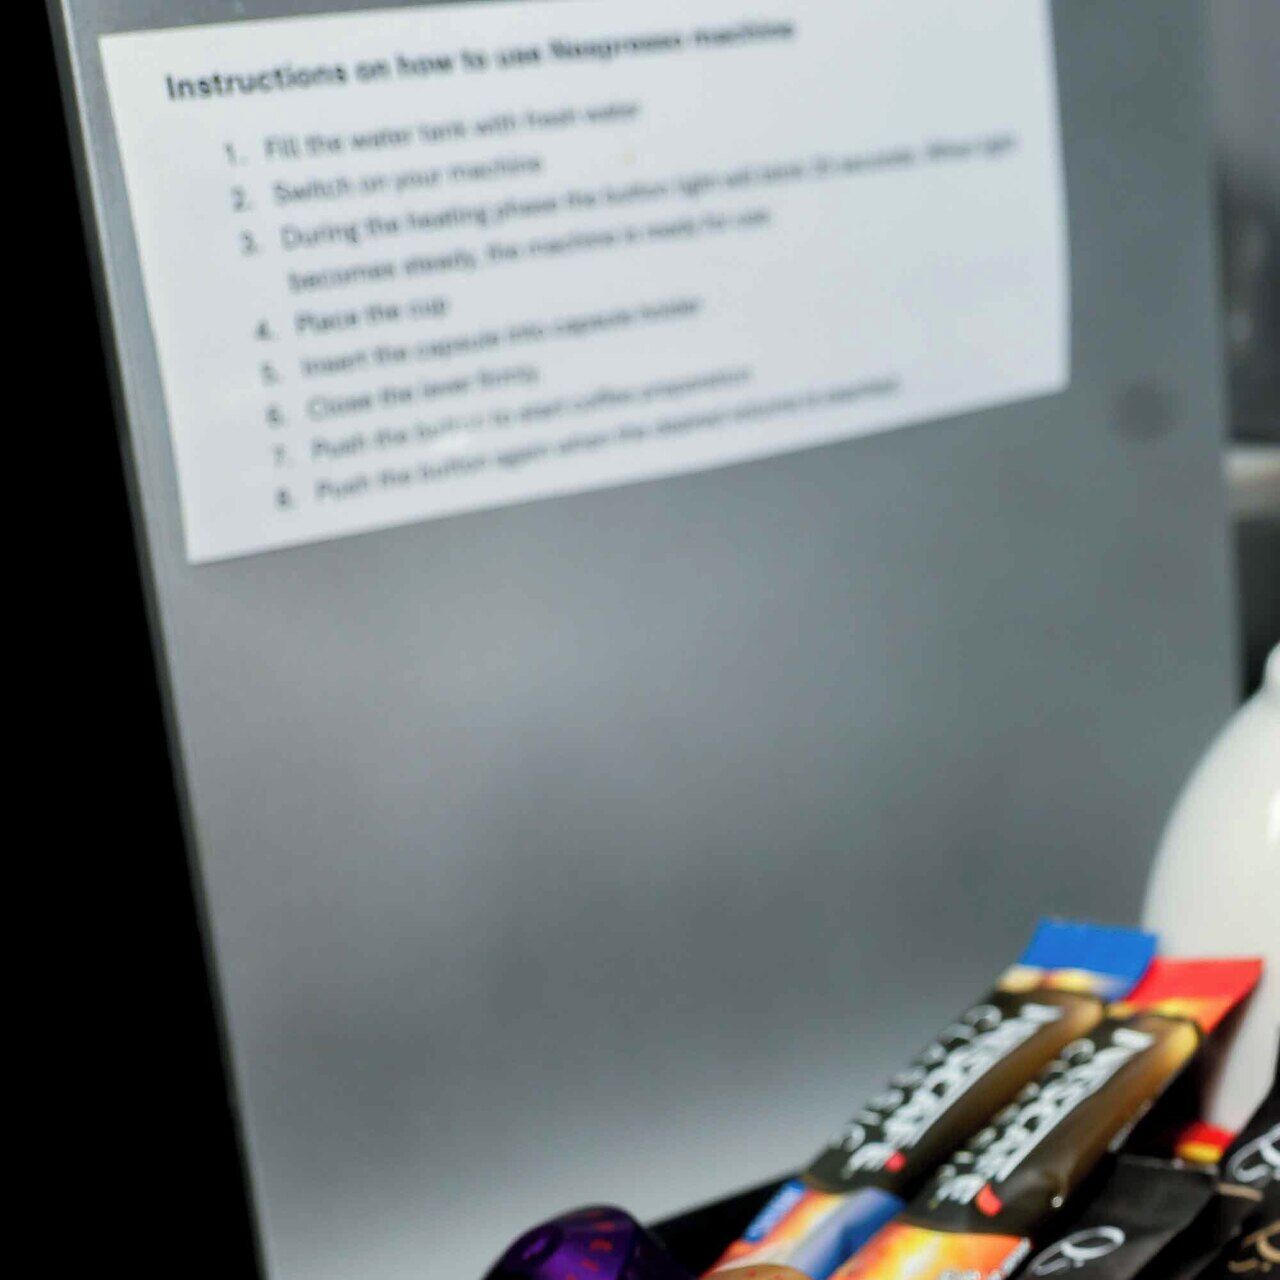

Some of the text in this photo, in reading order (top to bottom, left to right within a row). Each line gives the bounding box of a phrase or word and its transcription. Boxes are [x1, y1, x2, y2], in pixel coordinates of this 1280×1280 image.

[165, 61, 347, 100] Instructions
[355, 61, 388, 80] on
[396, 51, 453, 76] how
[460, 48, 487, 70] to
[496, 47, 540, 67] use
[264, 134, 299, 160] Fill
[304, 131, 342, 156] the
[350, 126, 411, 150] water
[271, 175, 352, 204] Switch
[360, 175, 386, 193] on
[395, 169, 443, 196] your
[449, 154, 542, 183] machine
[280, 217, 358, 251] During
[364, 212, 398, 235] the
[405, 202, 488, 235] heating
[286, 256, 394, 293] becomes
[294, 304, 358, 335] Place
[365, 300, 398, 324] the
[408, 295, 449, 321] cup
[301, 349, 367, 376] Insert
[373, 341, 406, 364] the
[304, 387, 372, 422] Close
[379, 381, 412, 405] the
[310, 430, 365, 461] Push
[313, 471, 369, 501] Push
